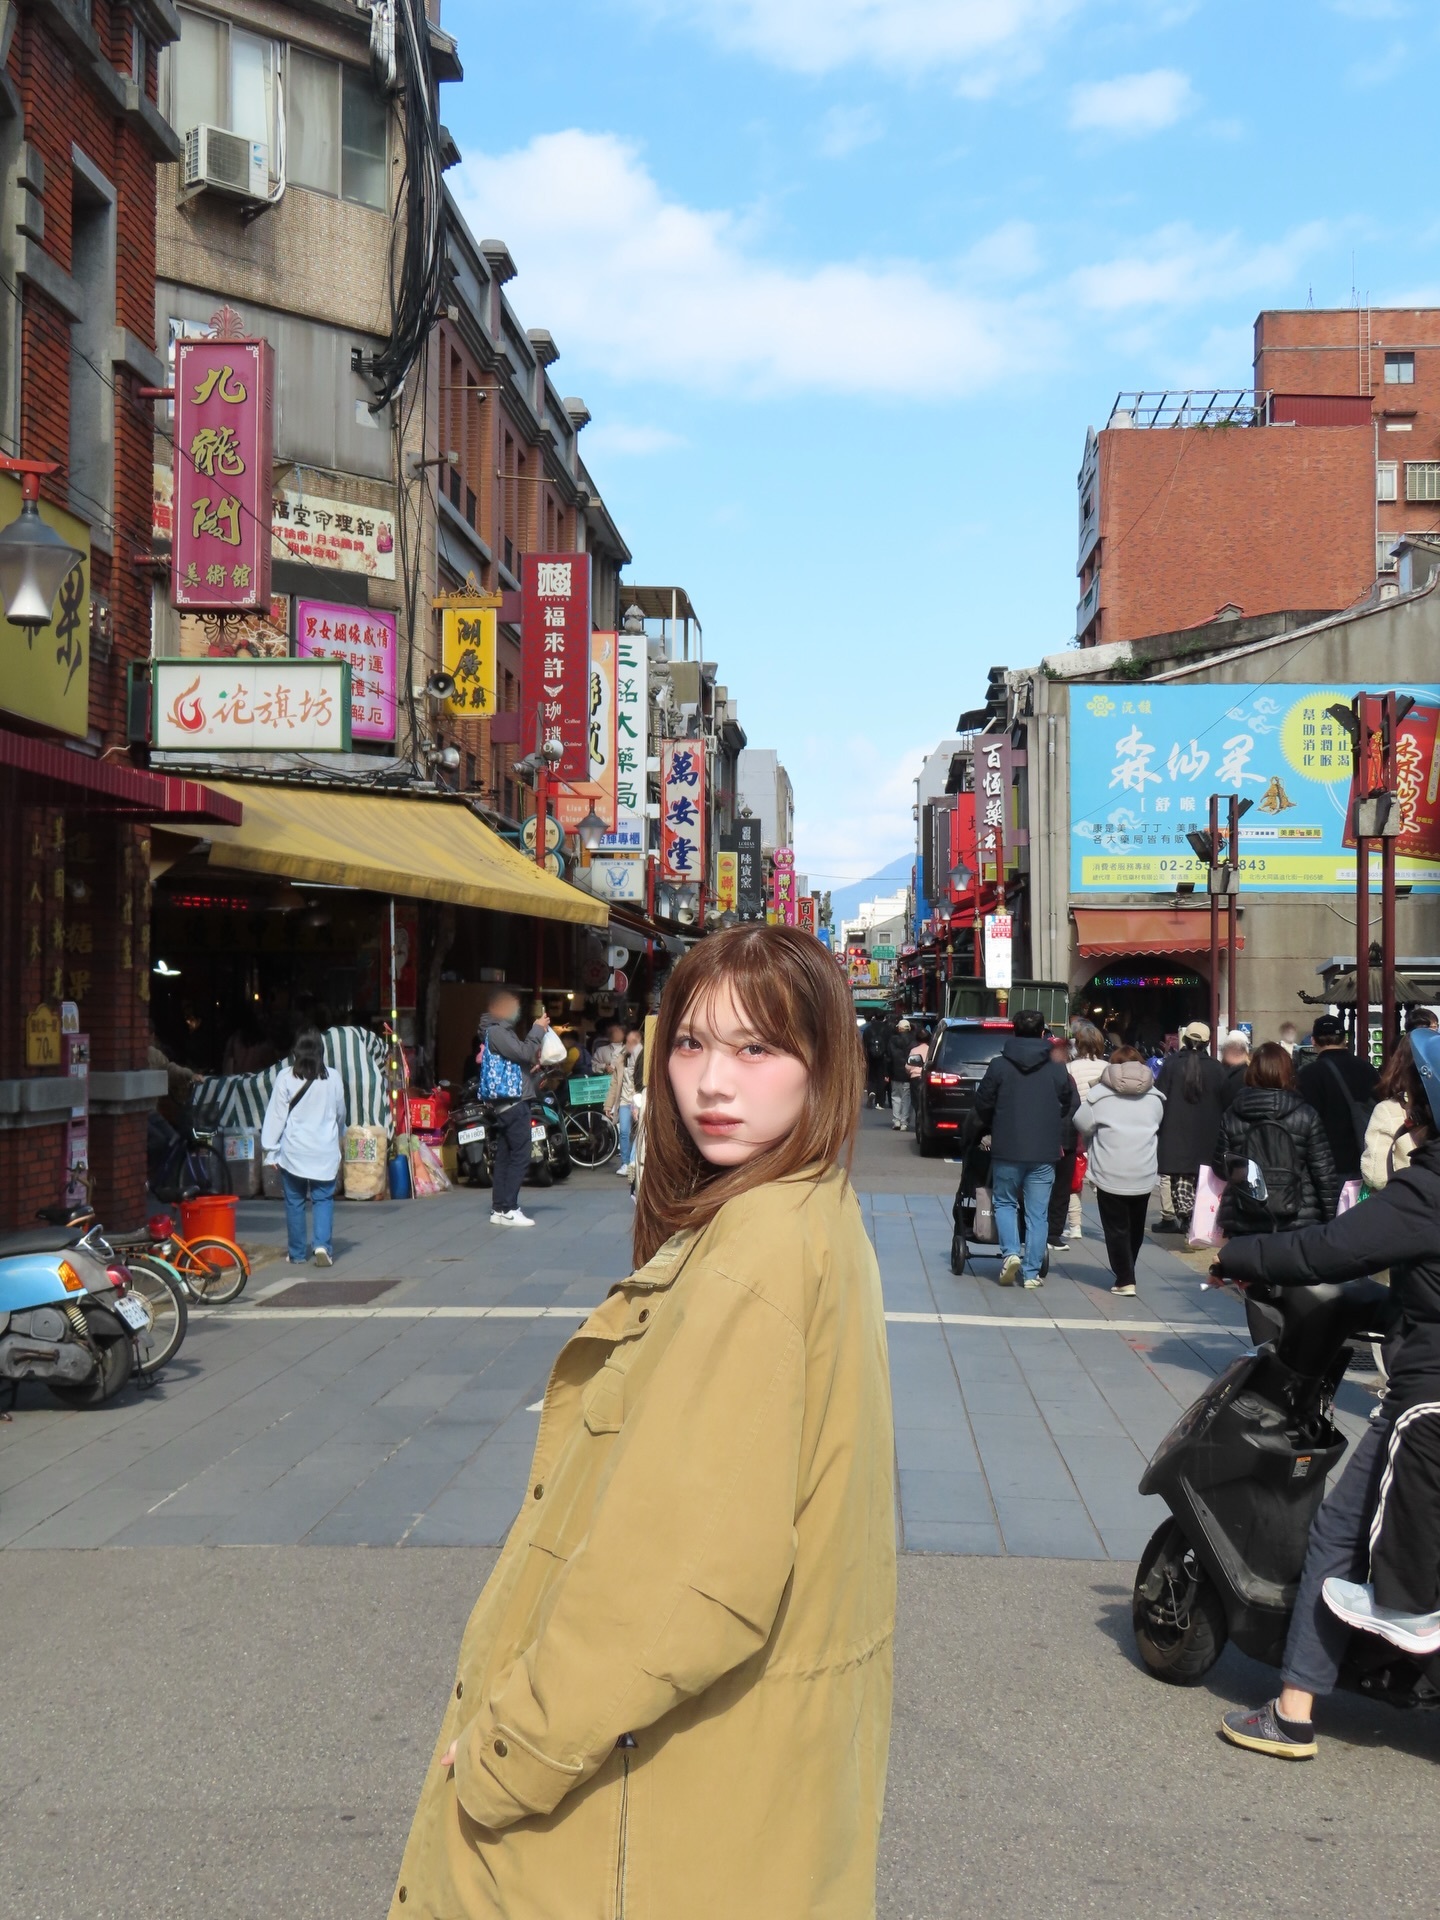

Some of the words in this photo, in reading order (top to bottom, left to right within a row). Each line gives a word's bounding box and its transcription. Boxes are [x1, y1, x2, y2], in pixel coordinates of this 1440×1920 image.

[182, 562, 252, 589] 美術館
[306, 617, 390, 649] 男女姻緣感情
[543, 606, 566, 679] 福來許
[212, 683, 334, 729] 花旗坊
[1108, 724, 1267, 793] 森仙果
[1303, 708, 1315, 767] 幫助消化
[666, 751, 700, 870] 萬安堂
